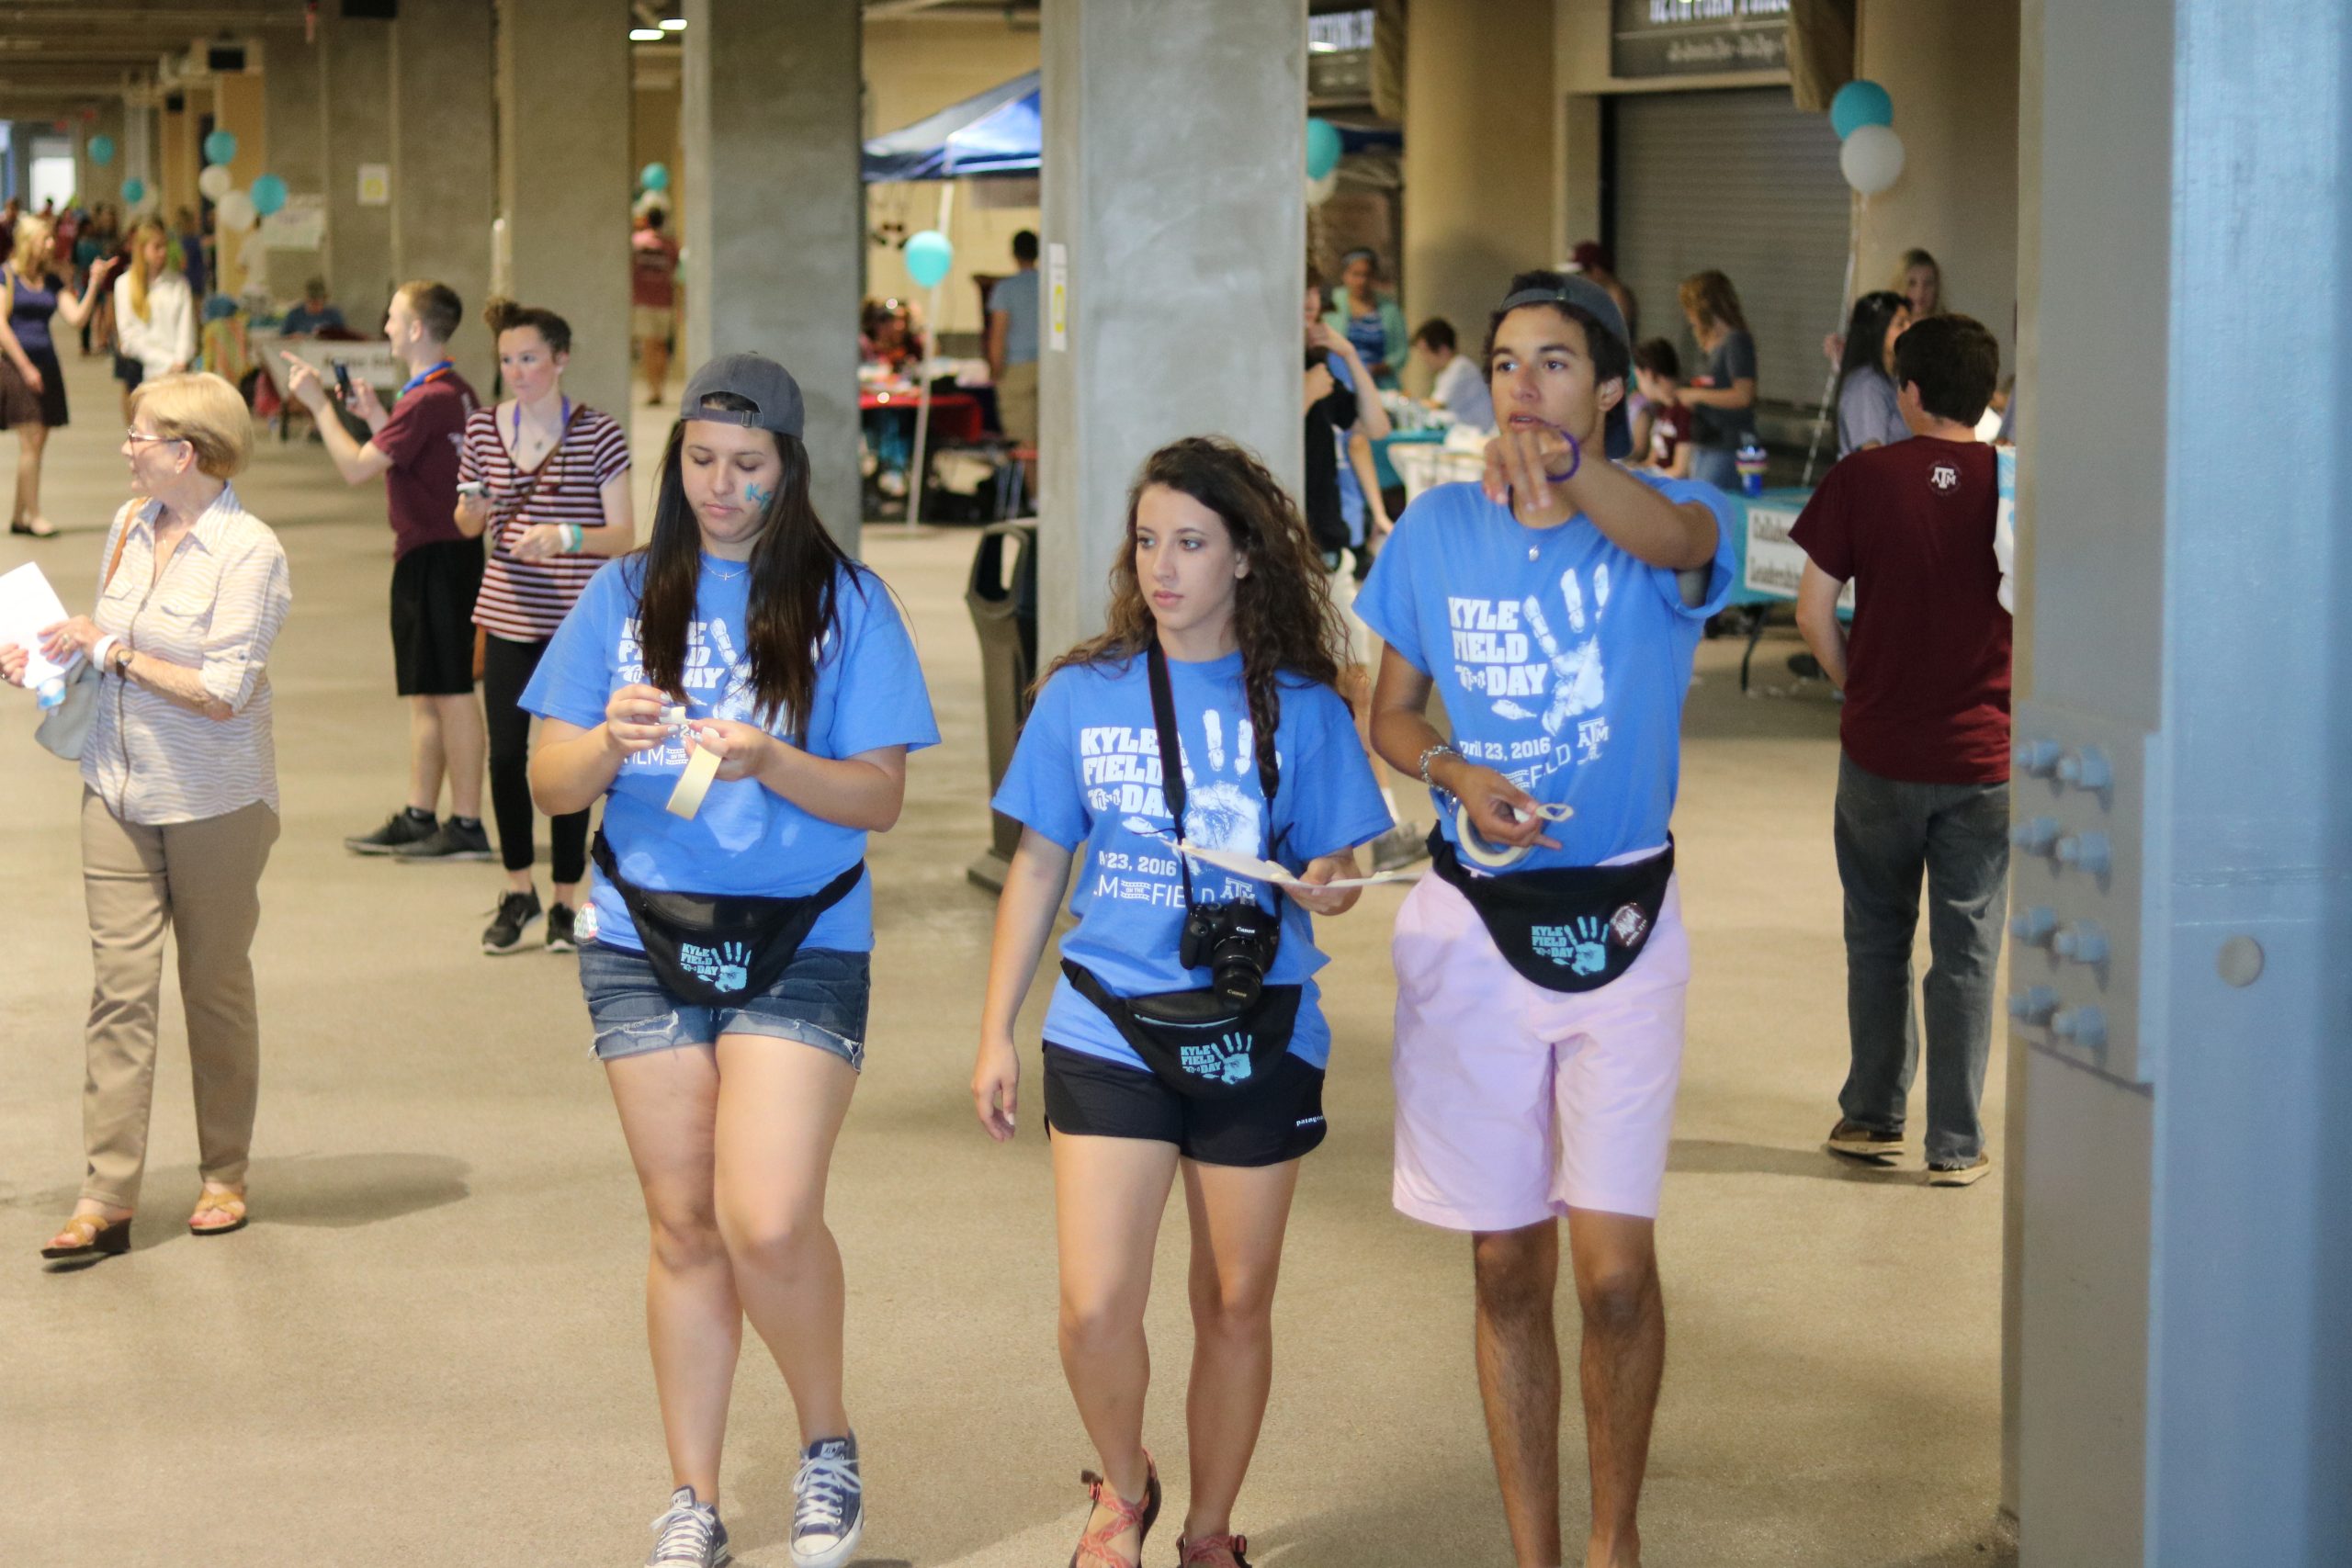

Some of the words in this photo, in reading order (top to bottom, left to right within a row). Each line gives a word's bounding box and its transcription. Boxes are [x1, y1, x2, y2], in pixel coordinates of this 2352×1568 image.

[1448, 597, 1521, 631] KYLE
[1452, 630, 1529, 664] FIELD
[1486, 663, 1548, 696] DAY
[1080, 727, 1160, 756] KYLE
[1485, 742, 1509, 761] 23,
[1510, 737, 1551, 759] 2016
[1082, 754, 1163, 787] FIELD
[1107, 852, 1133, 872] 23,
[1137, 856, 1177, 876] 2016
[1236, 926, 1256, 934] Canon
[1531, 926, 1564, 937] KYLE
[1531, 936, 1567, 947] FIELD
[682, 942, 711, 957] KYLE
[1551, 947, 1575, 958] DAY
[681, 952, 713, 965] FIELD
[696, 964, 719, 976] DAY
[1227, 988, 1248, 998] Canon
[1181, 1044, 1211, 1056] KYLE
[1181, 1055, 1216, 1066] FIELD
[1201, 1061, 1222, 1074] DAY
